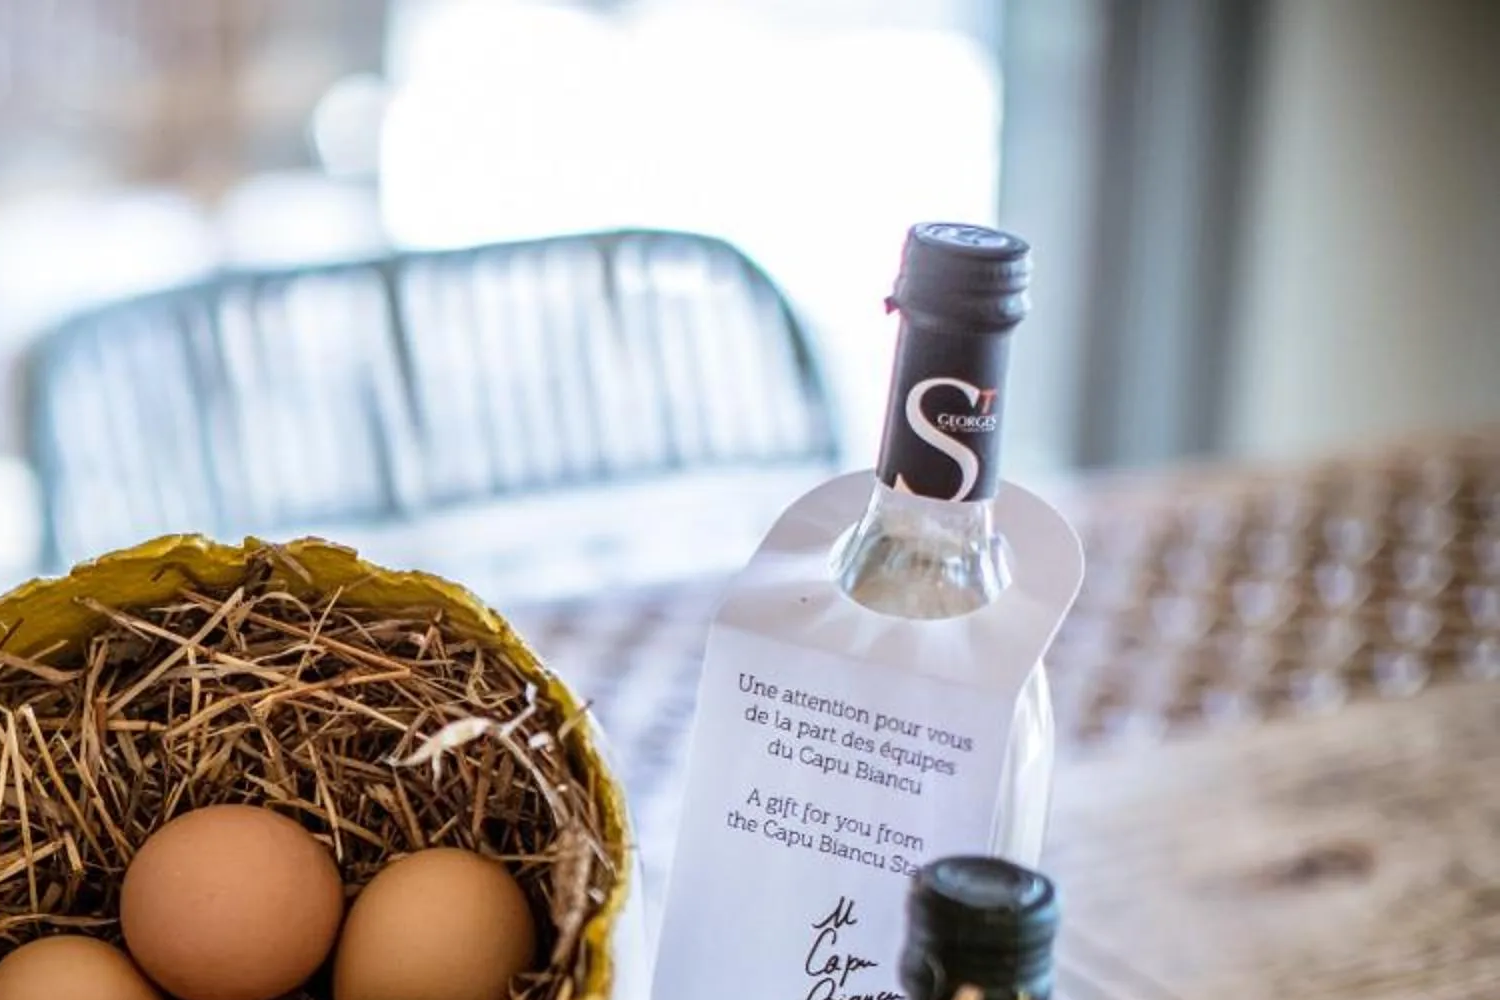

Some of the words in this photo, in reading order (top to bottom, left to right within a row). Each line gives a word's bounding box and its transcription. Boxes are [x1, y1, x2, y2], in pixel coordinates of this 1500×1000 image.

[739, 673, 778, 699] Une
[781, 689, 869, 724] attention
[873, 713, 923, 737] pour
[927, 727, 973, 752] vous
[745, 704, 769, 725] de
[775, 709, 791, 732] la
[797, 721, 837, 743] part
[841, 730, 875, 753] des
[879, 740, 956, 776] équipes
[767, 738, 793, 760] du
[799, 745, 849, 774] Capu
[855, 760, 922, 795] Biancu
[727, 810, 758, 832] the
[763, 819, 813, 848] Capu
[819, 833, 885, 869] Biancu
[889, 854, 921, 879] Sta
[746, 787, 761, 807] A
[765, 796, 799, 818] gift
[802, 802, 831, 825] for
[834, 815, 871, 837] you
[876, 823, 924, 853] from
[805, 928, 879, 988] Capu
